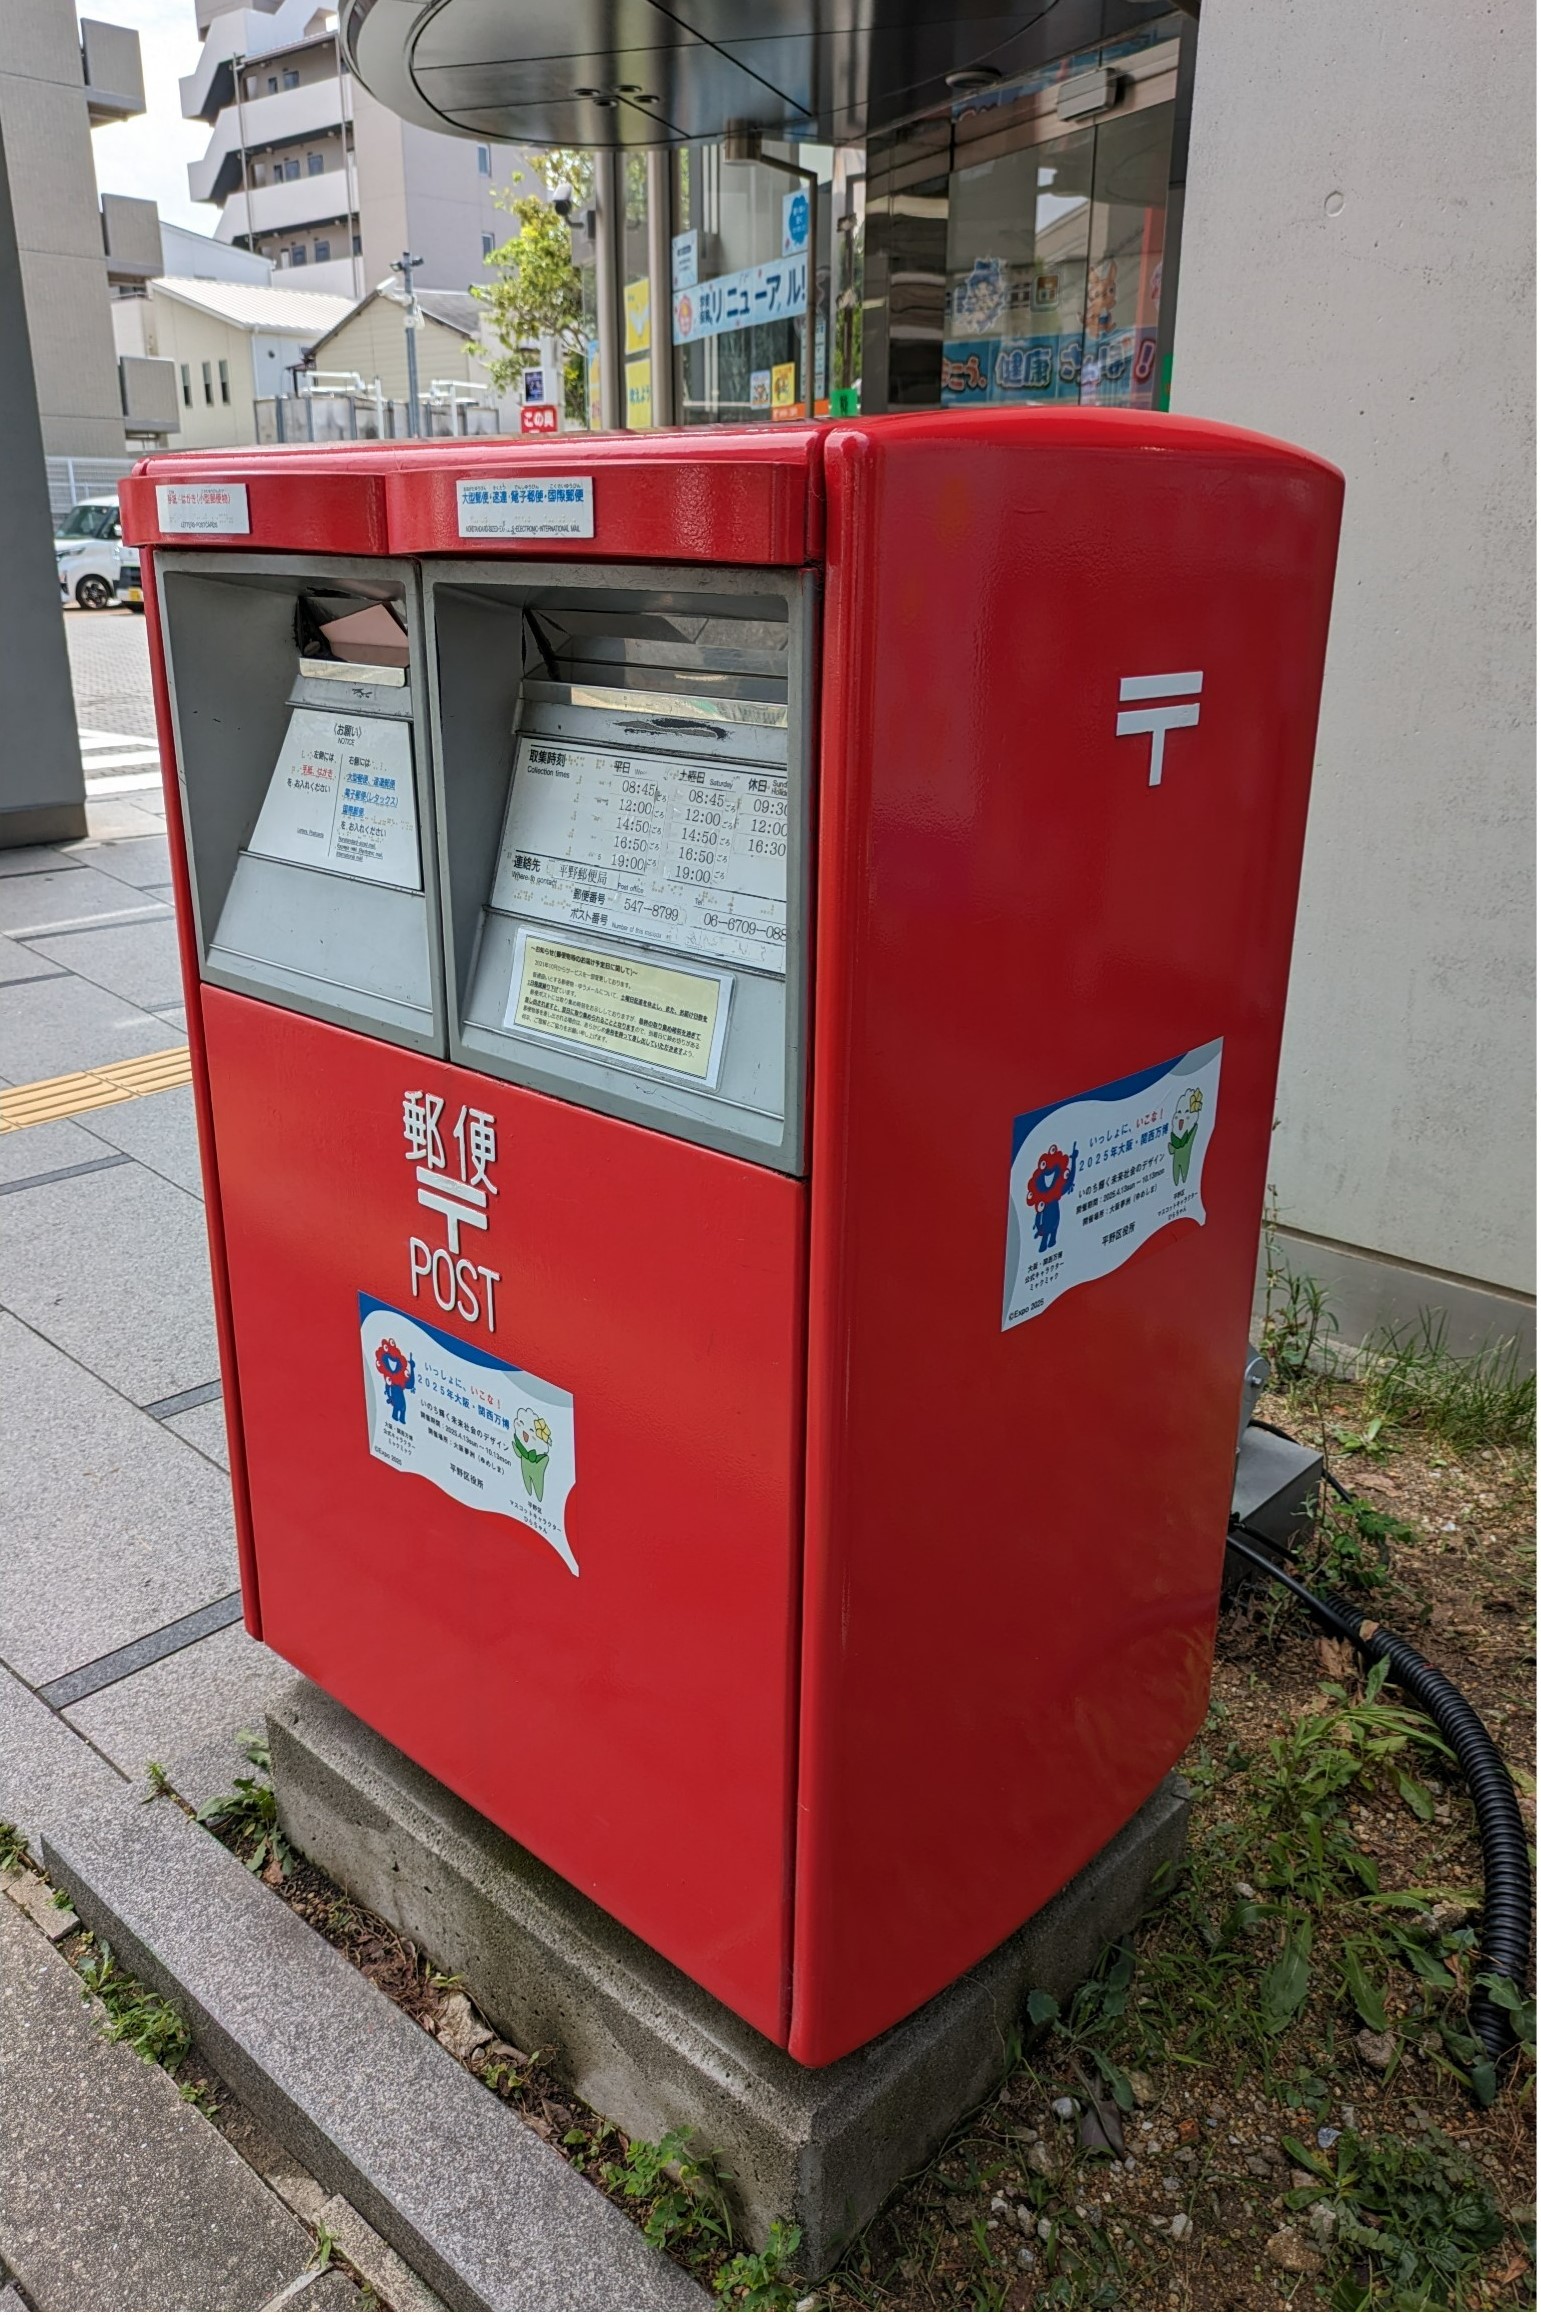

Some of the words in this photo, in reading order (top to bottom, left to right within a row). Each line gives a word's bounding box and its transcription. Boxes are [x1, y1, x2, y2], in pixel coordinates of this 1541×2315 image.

[995, 348, 1051, 388] 健康
[337, 737, 355, 746] NOTICE
[528, 749, 566, 767] 取集時刻
[613, 760, 631, 774] 平日
[527, 765, 554, 777] Collection
[555, 770, 570, 779] times
[678, 769, 706, 784] 土曜日
[709, 779, 733, 790] Saturday
[622, 779, 656, 796] 08:45
[748, 778, 767, 792] 休日
[619, 798, 652, 815] 12:00
[688, 789, 725, 807] 08:45
[616, 817, 650, 834] 14:50
[685, 808, 721, 826] 12:00
[613, 835, 648, 852] 16:50
[681, 827, 717, 845] 14:50
[678, 846, 714, 864] 16:50
[748, 839, 786, 856] 16:30
[513, 855, 541, 873] 連絡先
[560, 864, 608, 885] 平野郵便局
[611, 853, 645, 871] 19:00
[675, 865, 711, 883] 19:00
[573, 887, 606, 906] 郵便番号
[624, 898, 679, 921] 547-8799
[569, 907, 608, 926] ポスト番号
[402, 1090, 498, 1195] 郵便
[1078, 1122, 1169, 1172] 2025年大阪・関西万博
[1078, 1153, 1165, 1199] いのち輝く未来社会のデザイン
[1101, 1221, 1136, 1246] 平野区役所
[409, 1236, 500, 1333] POST
[417, 1373, 510, 1431] 2025年大阪・関西万博
[420, 1399, 510, 1451] いのち輝く未来社会のデザイン
[450, 1462, 484, 1490] 平野区役所
